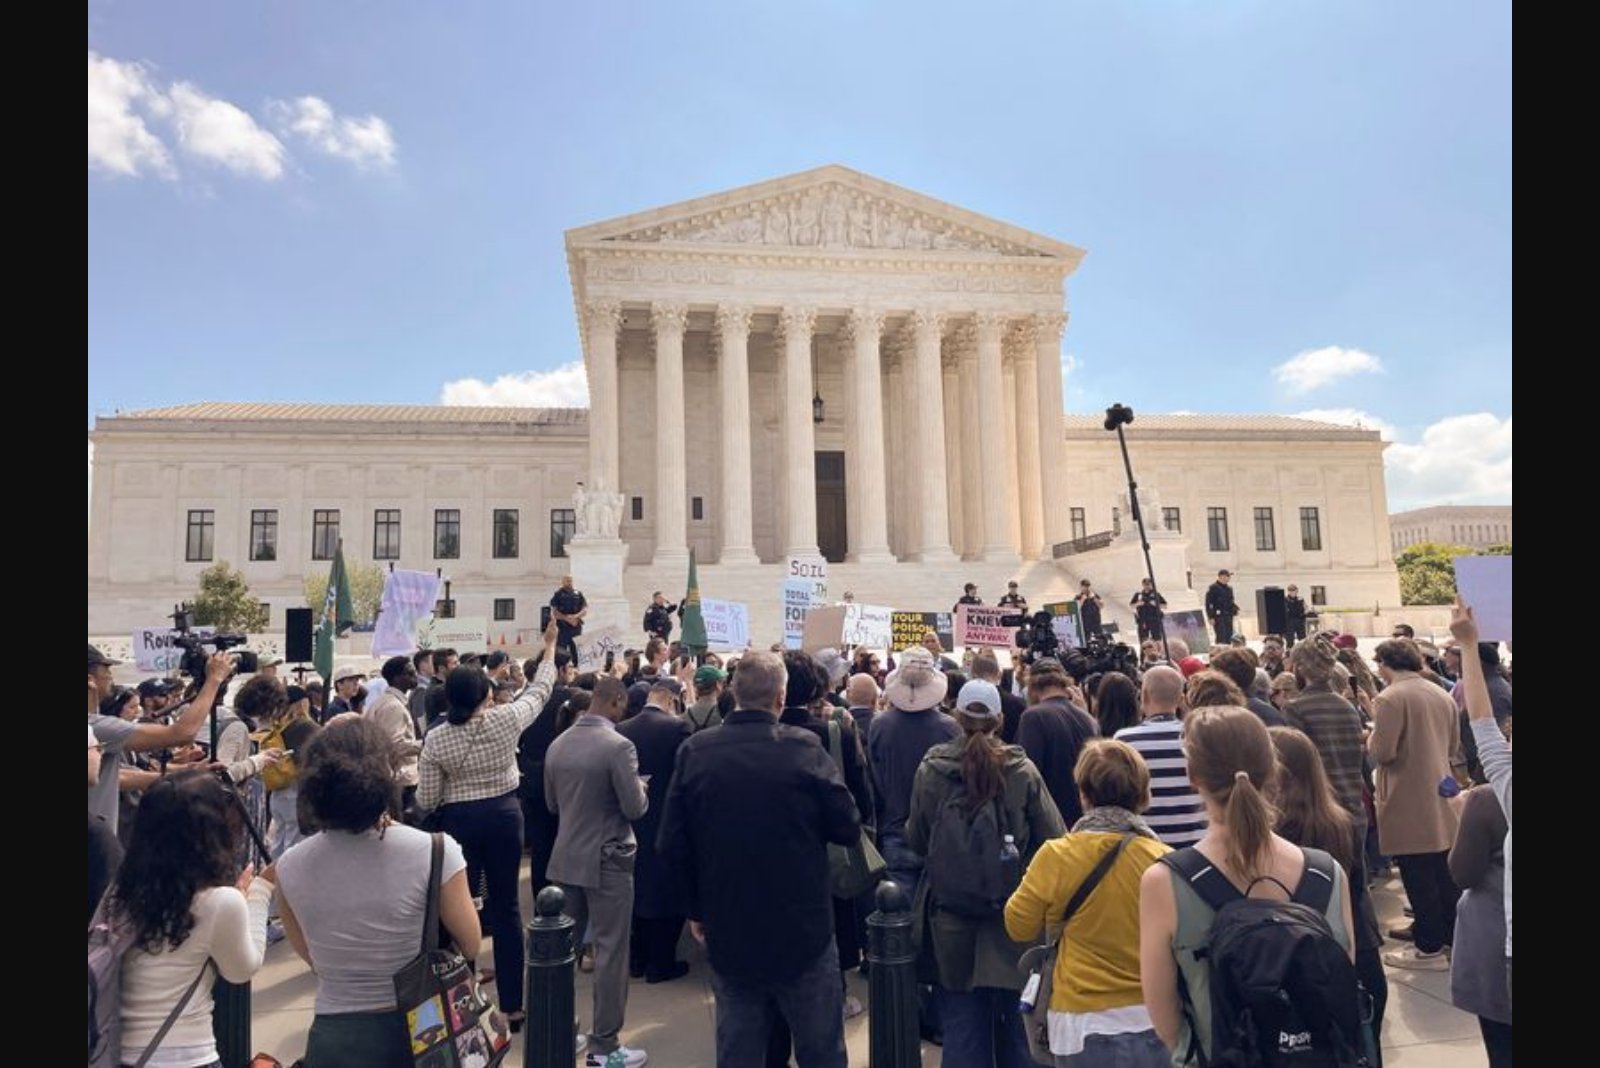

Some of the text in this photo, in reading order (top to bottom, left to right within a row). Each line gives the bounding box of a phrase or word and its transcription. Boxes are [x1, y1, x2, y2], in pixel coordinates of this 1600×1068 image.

[790, 560, 826, 578] SOIL
[893, 613, 922, 622] YOUR
[893, 623, 934, 634] POISON
[893, 633, 922, 642] YOUR
